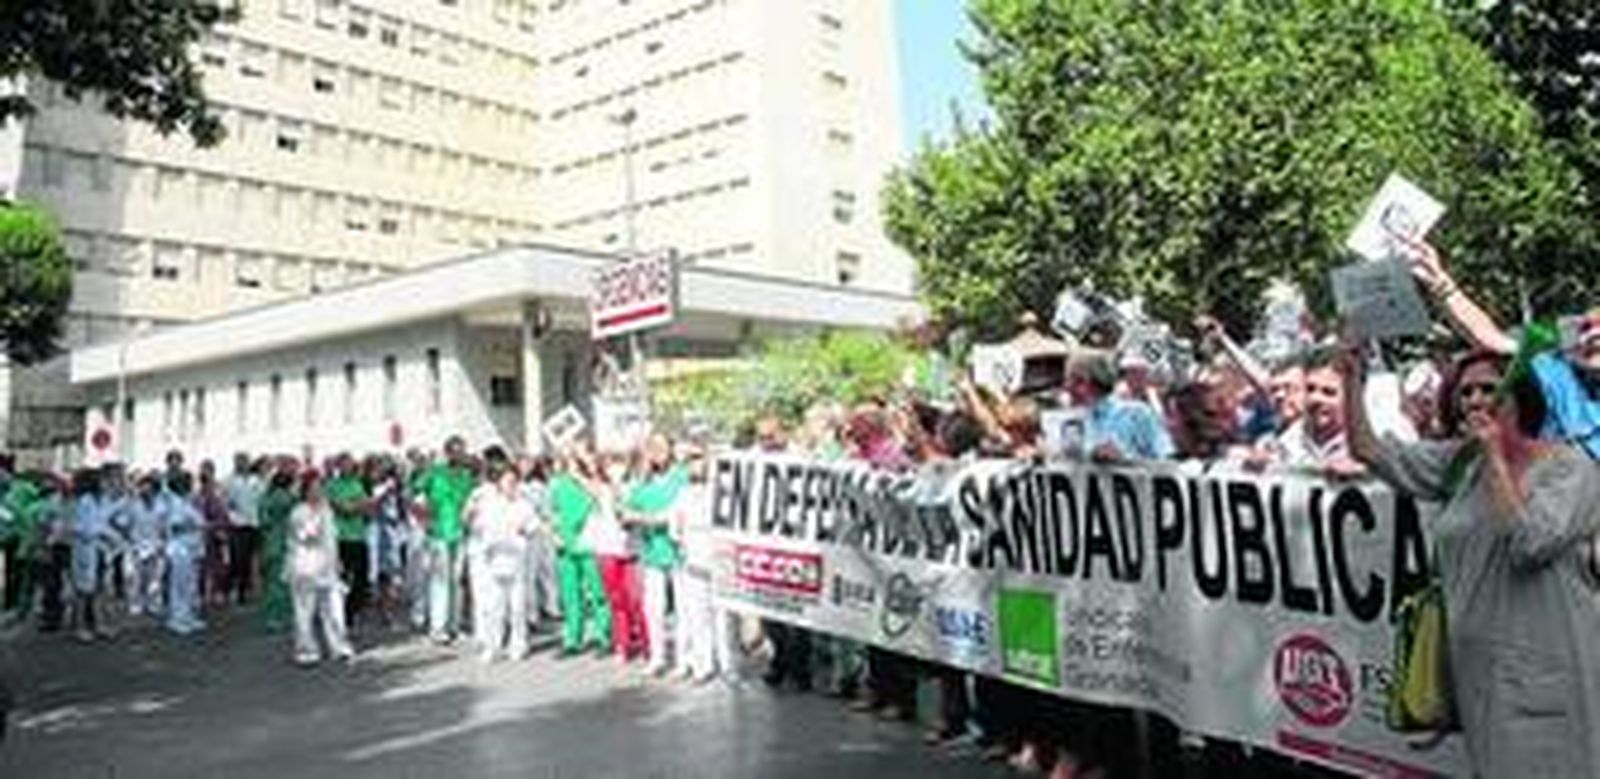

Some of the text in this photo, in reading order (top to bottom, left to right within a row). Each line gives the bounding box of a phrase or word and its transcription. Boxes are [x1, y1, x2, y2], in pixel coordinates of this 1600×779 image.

[712, 459, 753, 527] EN
[959, 472, 1143, 581] SANIDAD
[1153, 477, 1429, 624] PUBLICA
